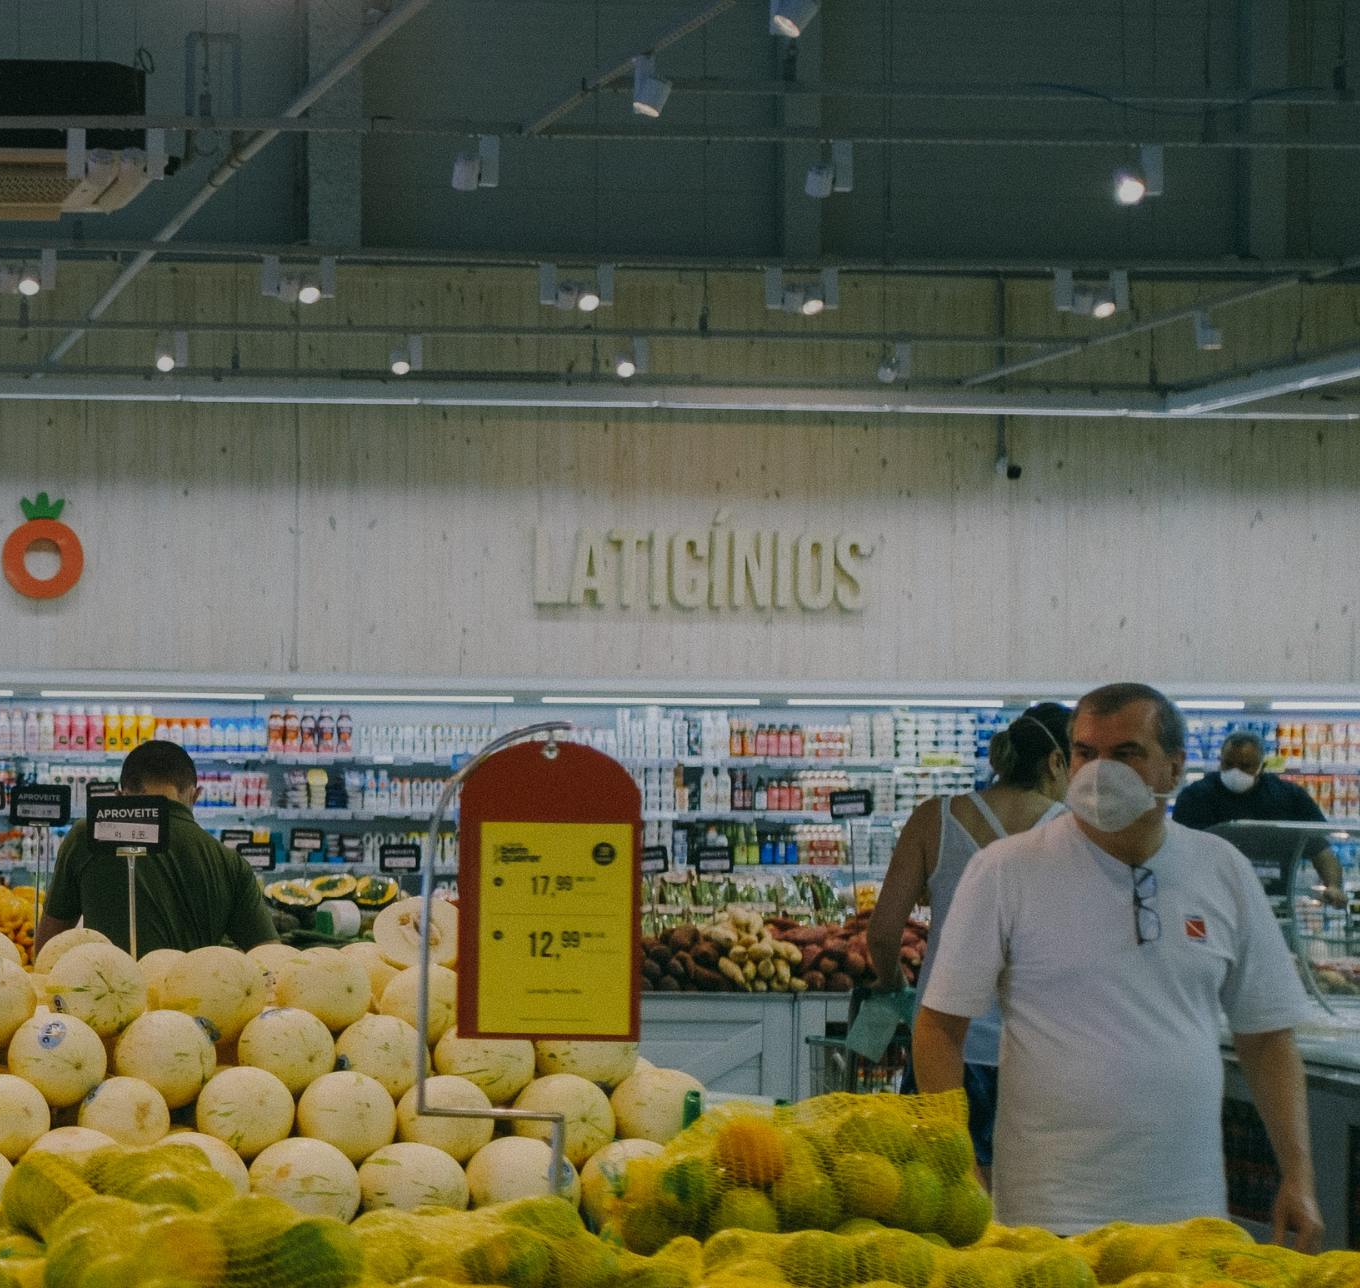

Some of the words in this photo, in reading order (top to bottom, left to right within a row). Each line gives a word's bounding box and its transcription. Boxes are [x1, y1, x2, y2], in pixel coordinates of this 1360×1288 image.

[531, 506, 875, 612] LATICÍNIOS
[18, 793, 61, 801] APROVEITE
[96, 807, 160, 819] APROVEITE
